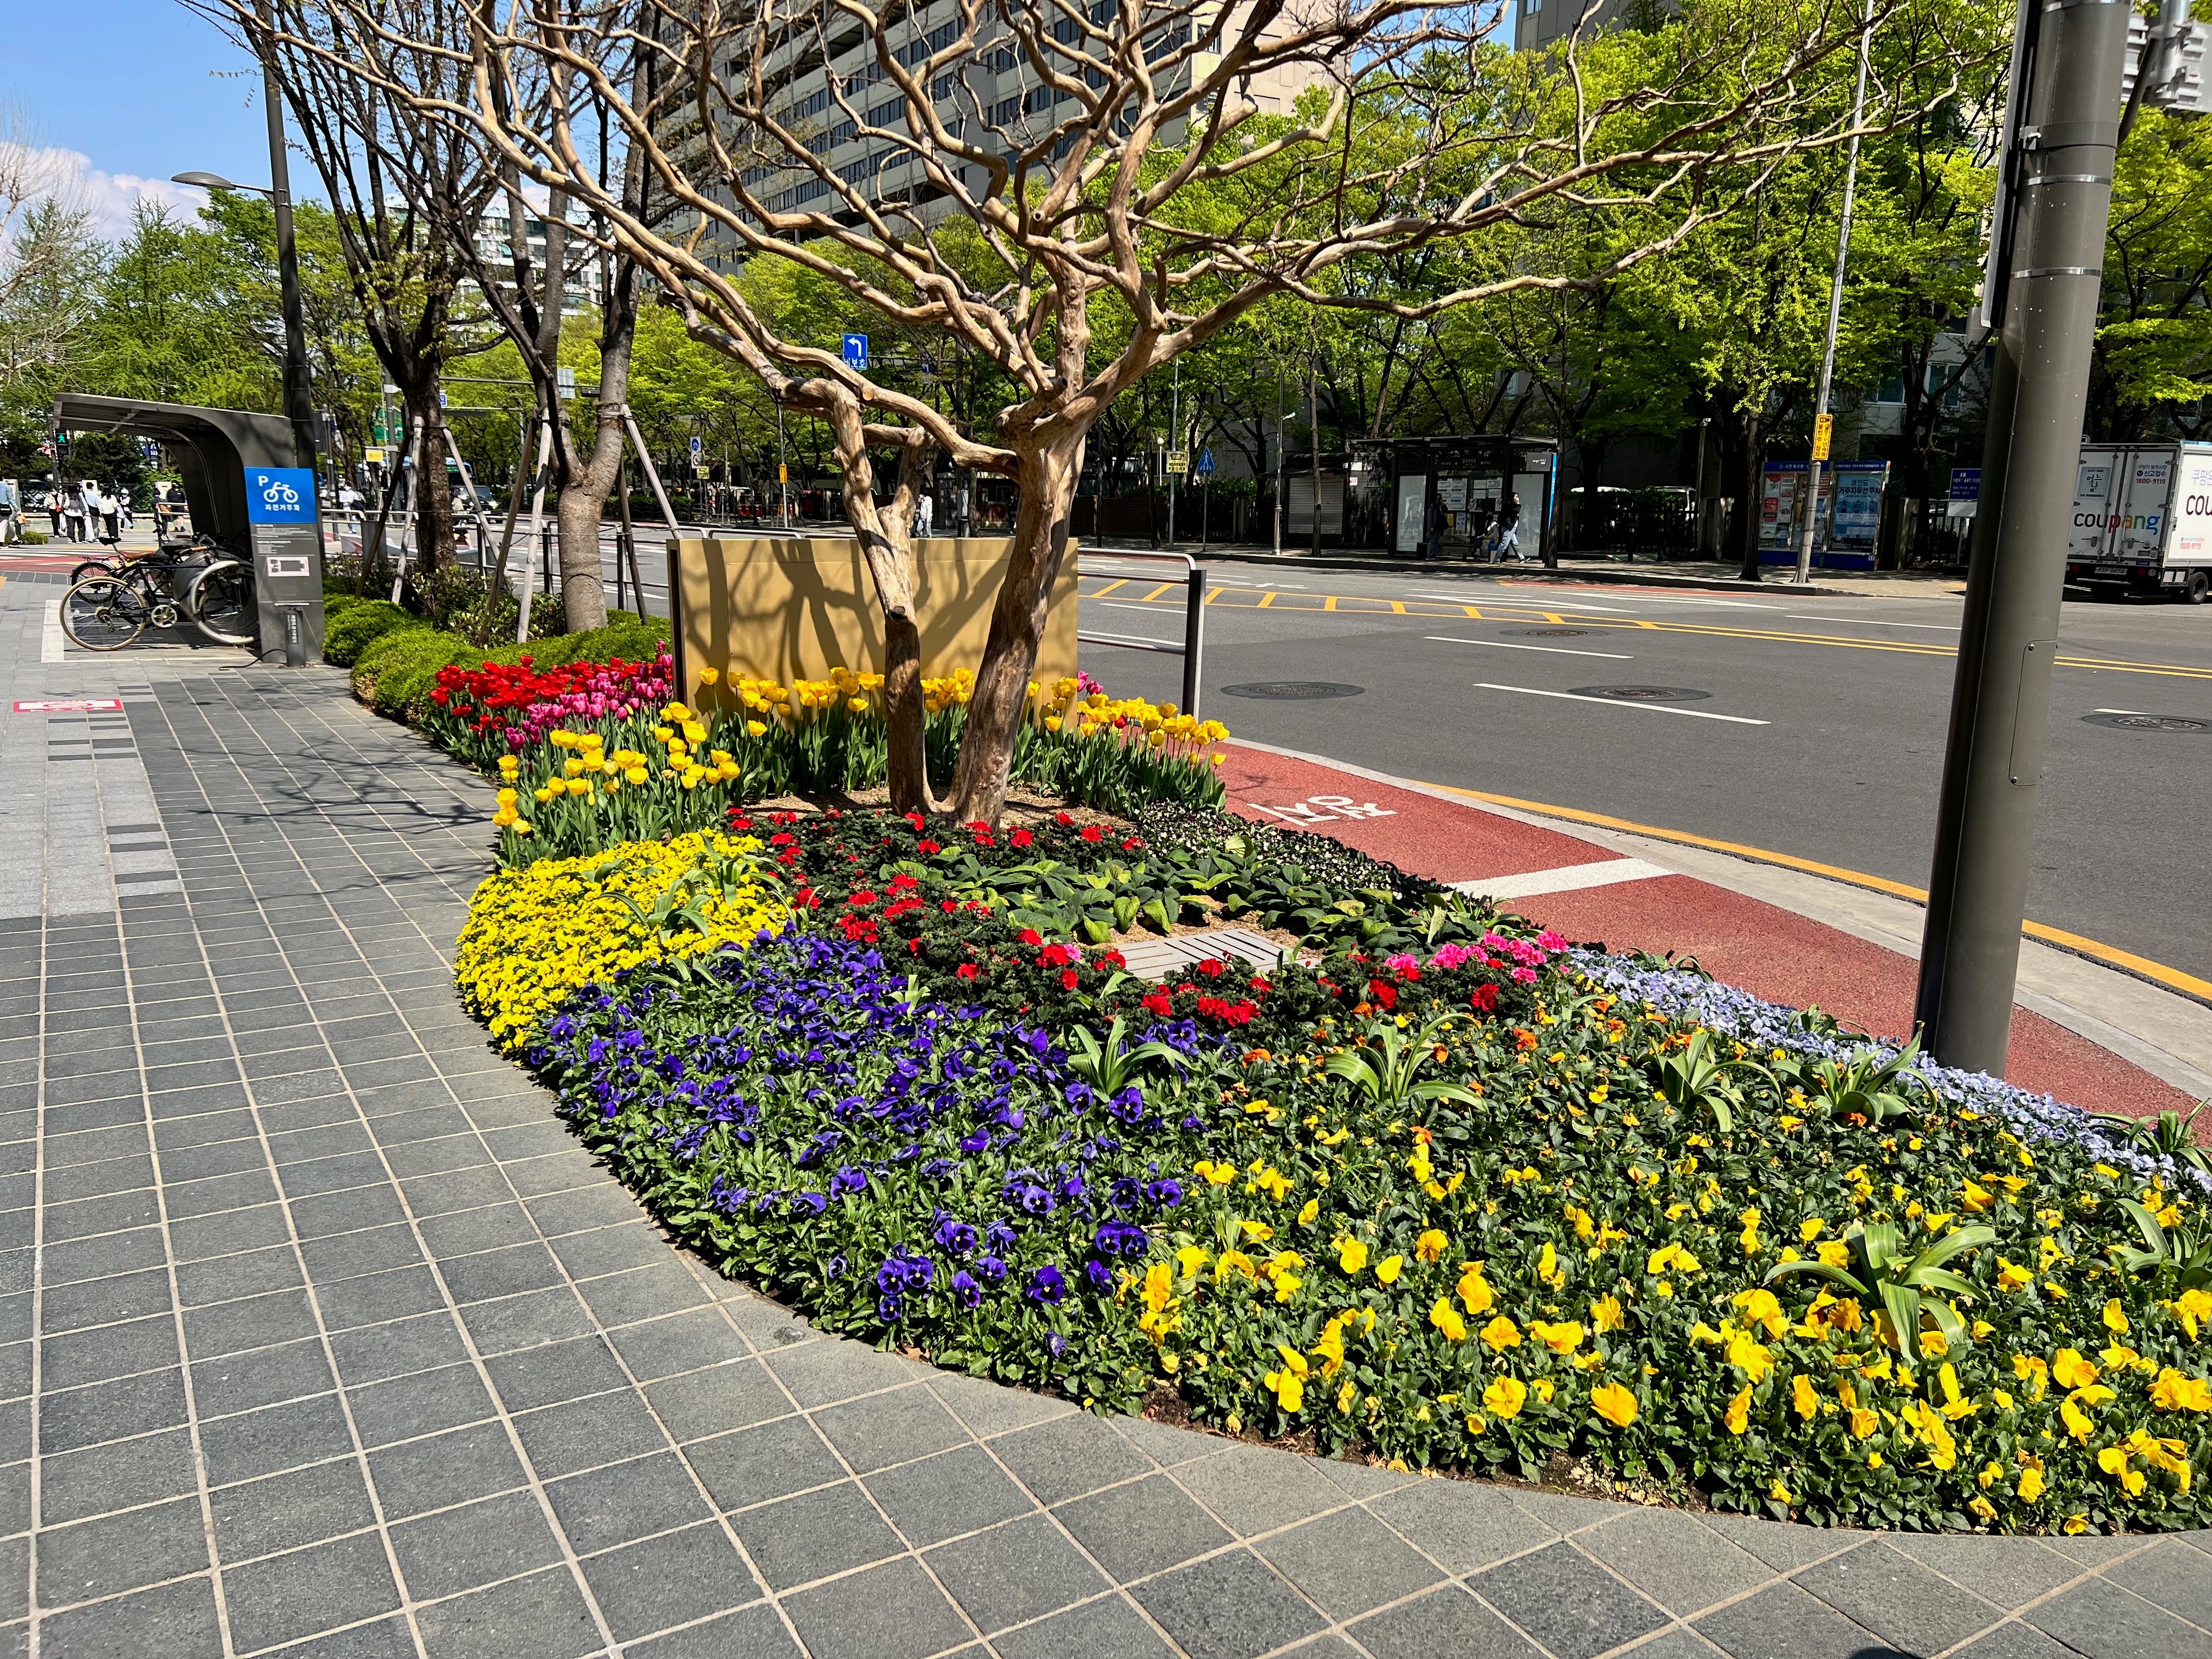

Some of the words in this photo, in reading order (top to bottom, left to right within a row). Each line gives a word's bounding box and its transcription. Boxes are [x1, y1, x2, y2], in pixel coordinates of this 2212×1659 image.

[844, 358, 866, 368] 비보호
[258, 475, 269, 487] P
[2086, 473, 2102, 482] 어느
[2090, 481, 2098, 492] 날
[264, 504, 300, 512] 자전거주차
[2074, 513, 2161, 535] coupang
[1246, 795, 1397, 827] 정지
